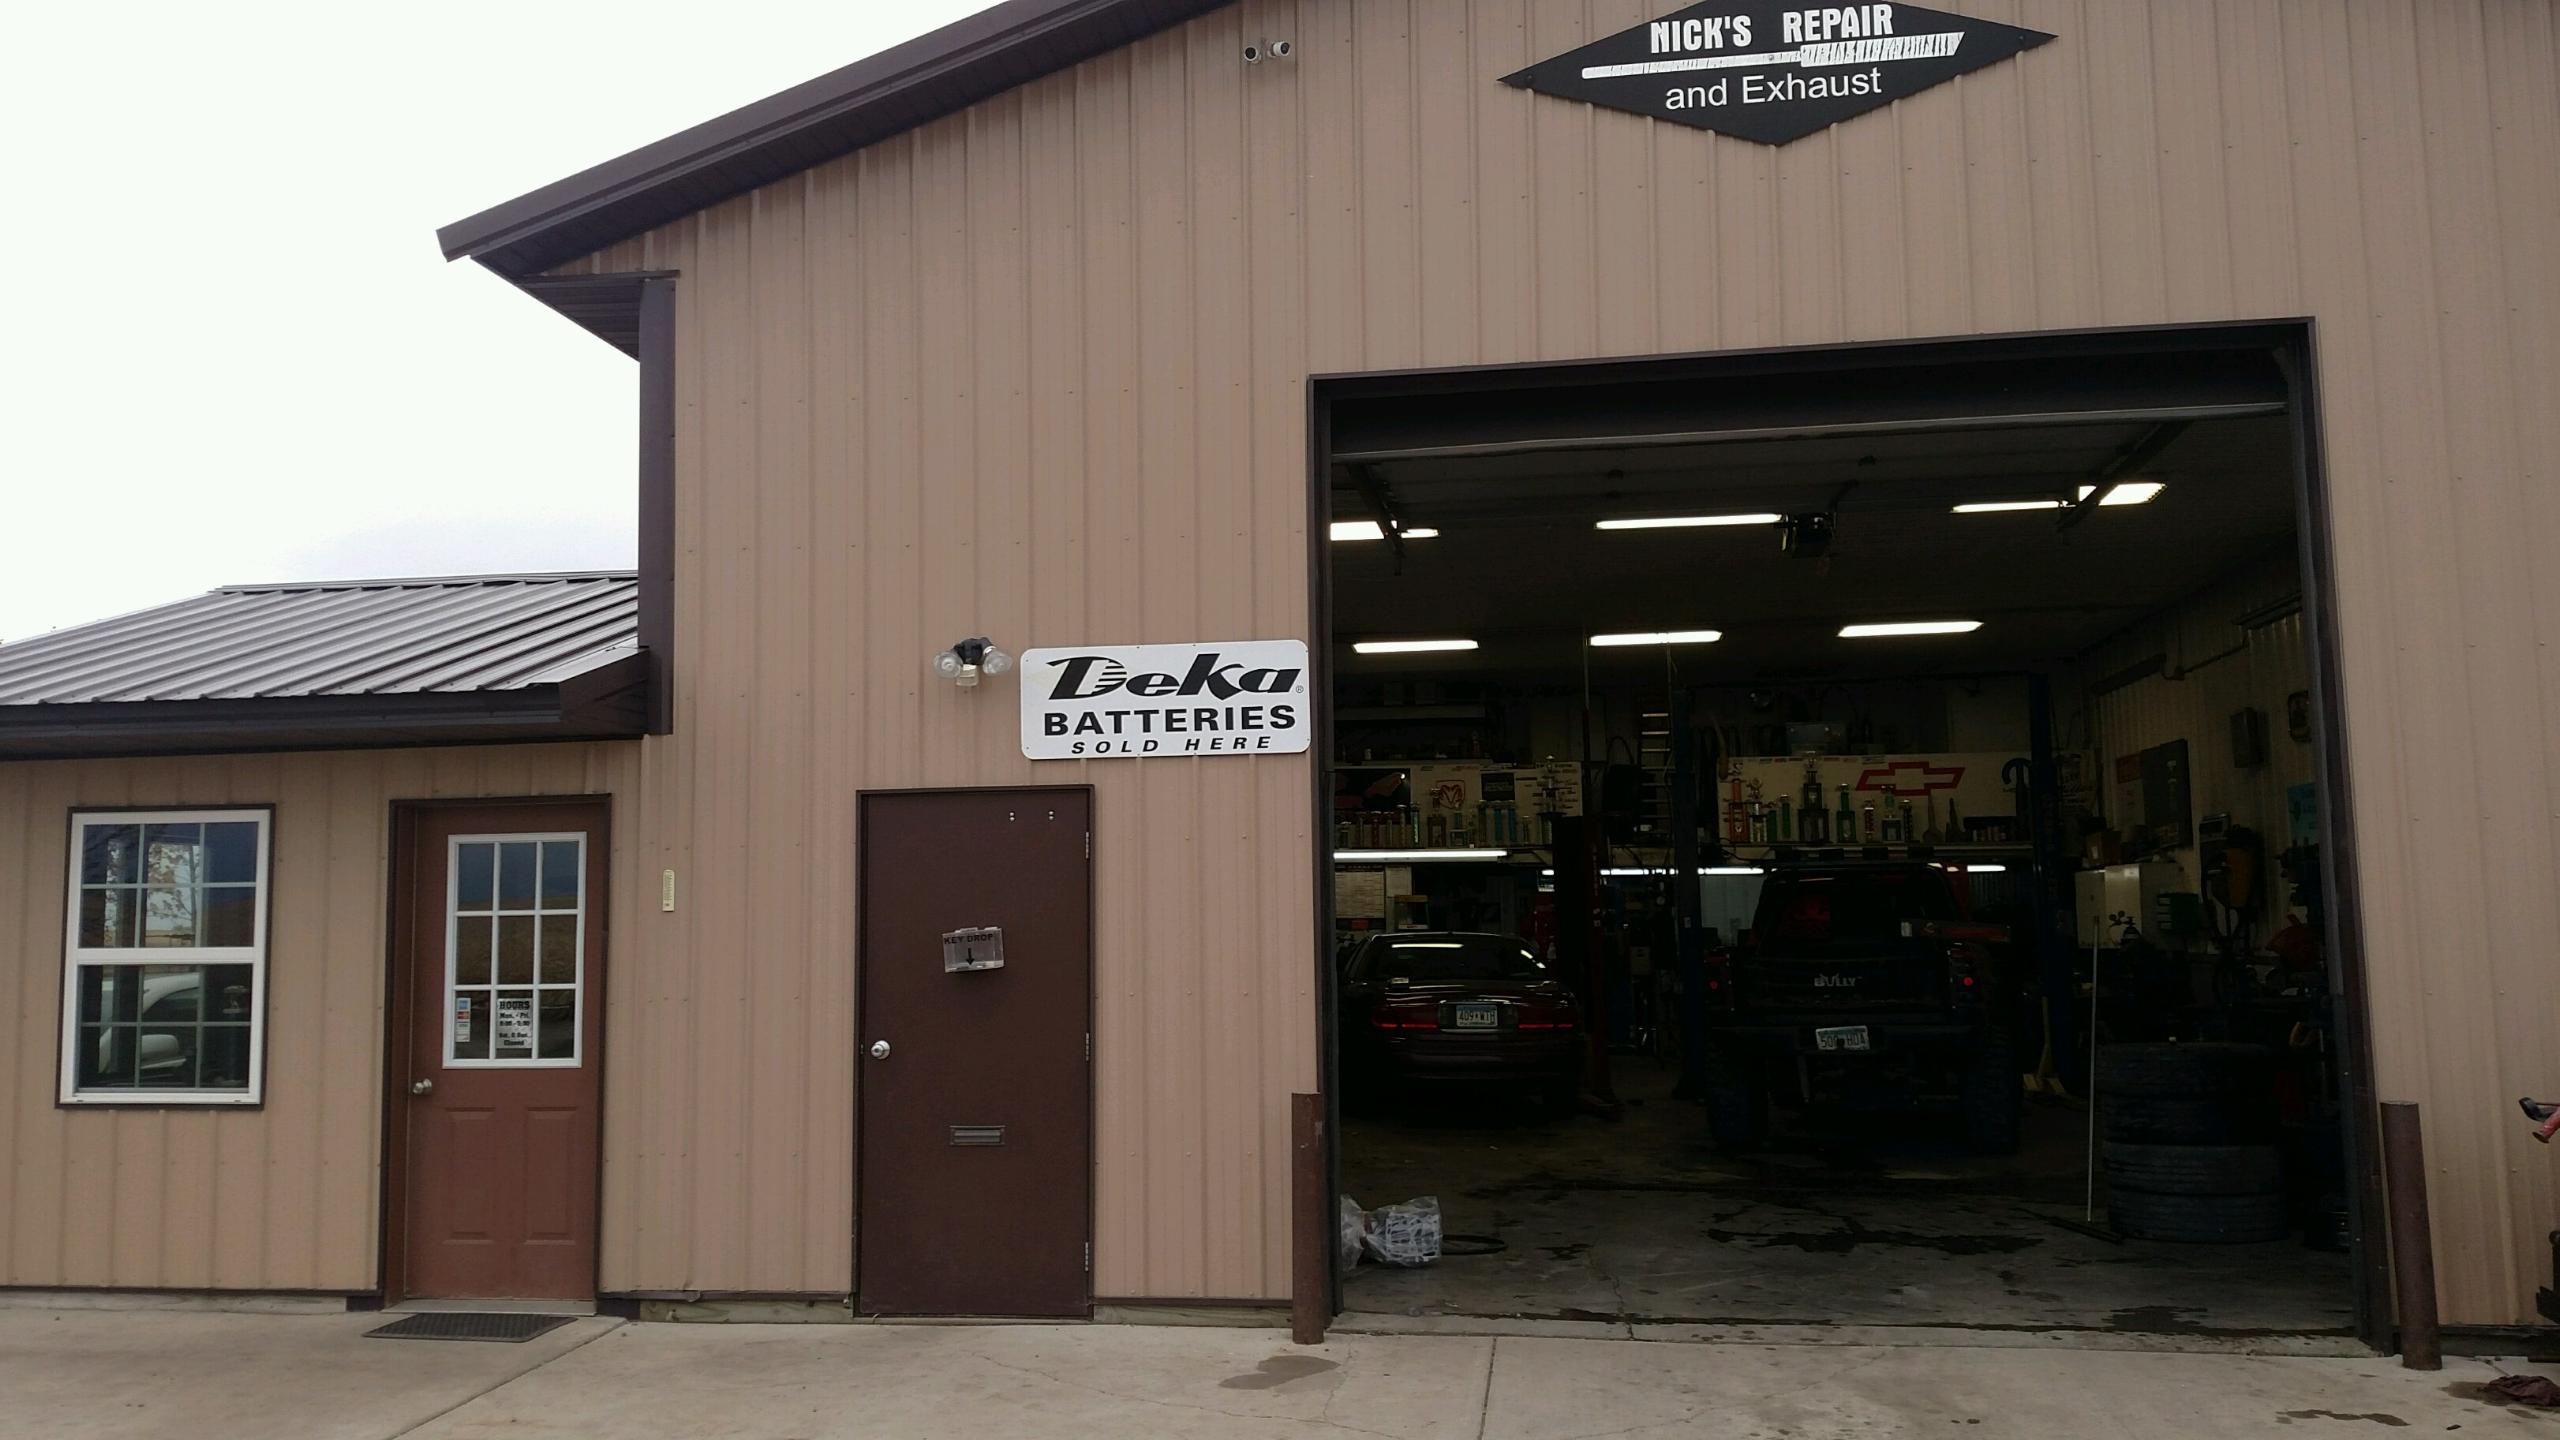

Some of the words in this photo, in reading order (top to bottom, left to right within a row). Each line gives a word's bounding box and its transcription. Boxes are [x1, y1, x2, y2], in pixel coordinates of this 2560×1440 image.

[1650, 15, 1752, 53] NICK'S
[1783, 4, 1894, 44] REPAIR
[1665, 77, 1728, 110] and
[1742, 67, 1882, 104] Exhaust
[1046, 653, 1302, 700] Deka
[1044, 705, 1296, 737] BATTERIES
[1071, 739, 1159, 754] SOLD
[1185, 736, 1272, 751] HERE
[944, 936, 964, 945] KEY
[967, 933, 994, 943] DROP
[499, 1001, 530, 1010] HOURS
